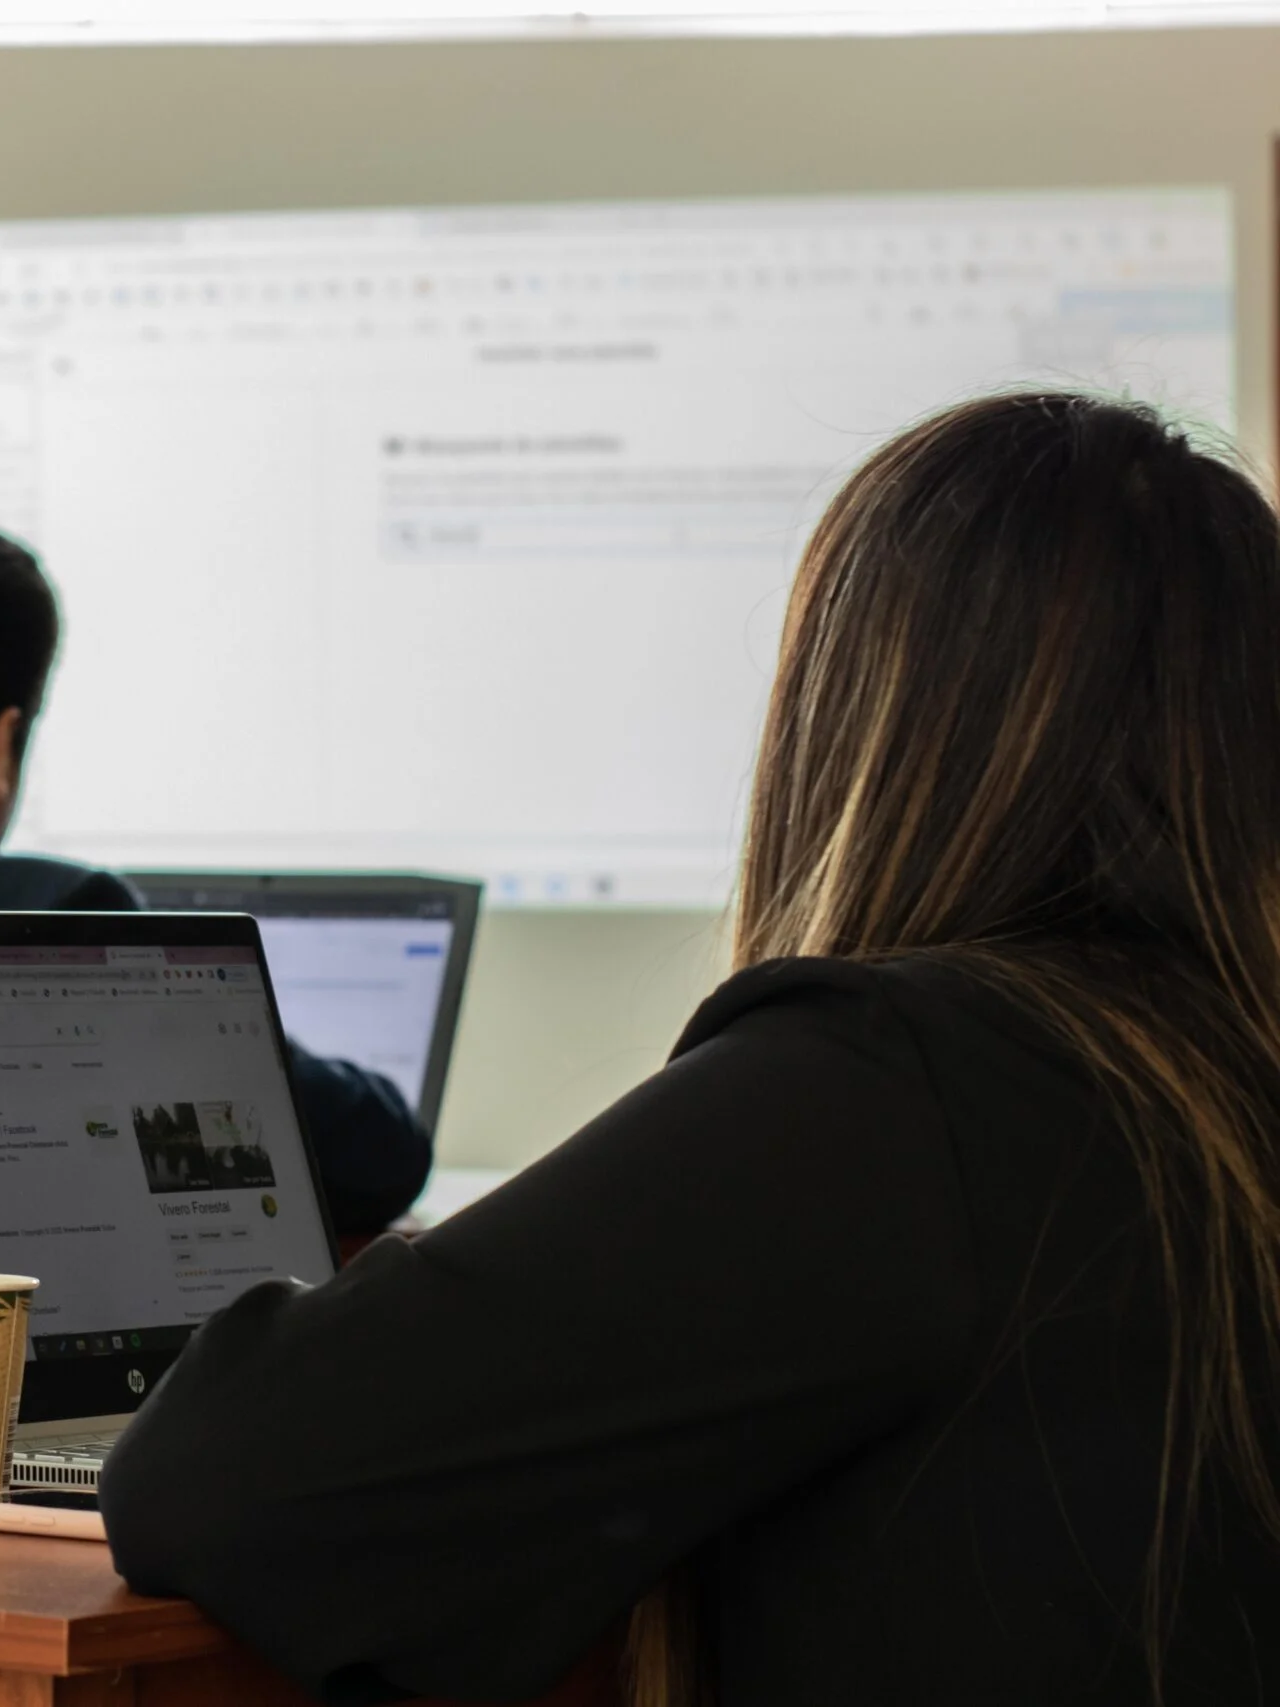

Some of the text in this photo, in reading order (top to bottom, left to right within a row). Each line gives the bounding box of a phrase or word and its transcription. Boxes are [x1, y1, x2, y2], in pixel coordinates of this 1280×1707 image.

[3, 1124, 37, 1136] Facebook
[158, 1200, 232, 1216] Vivero Forestal
[128, 1369, 145, 1394] hp
